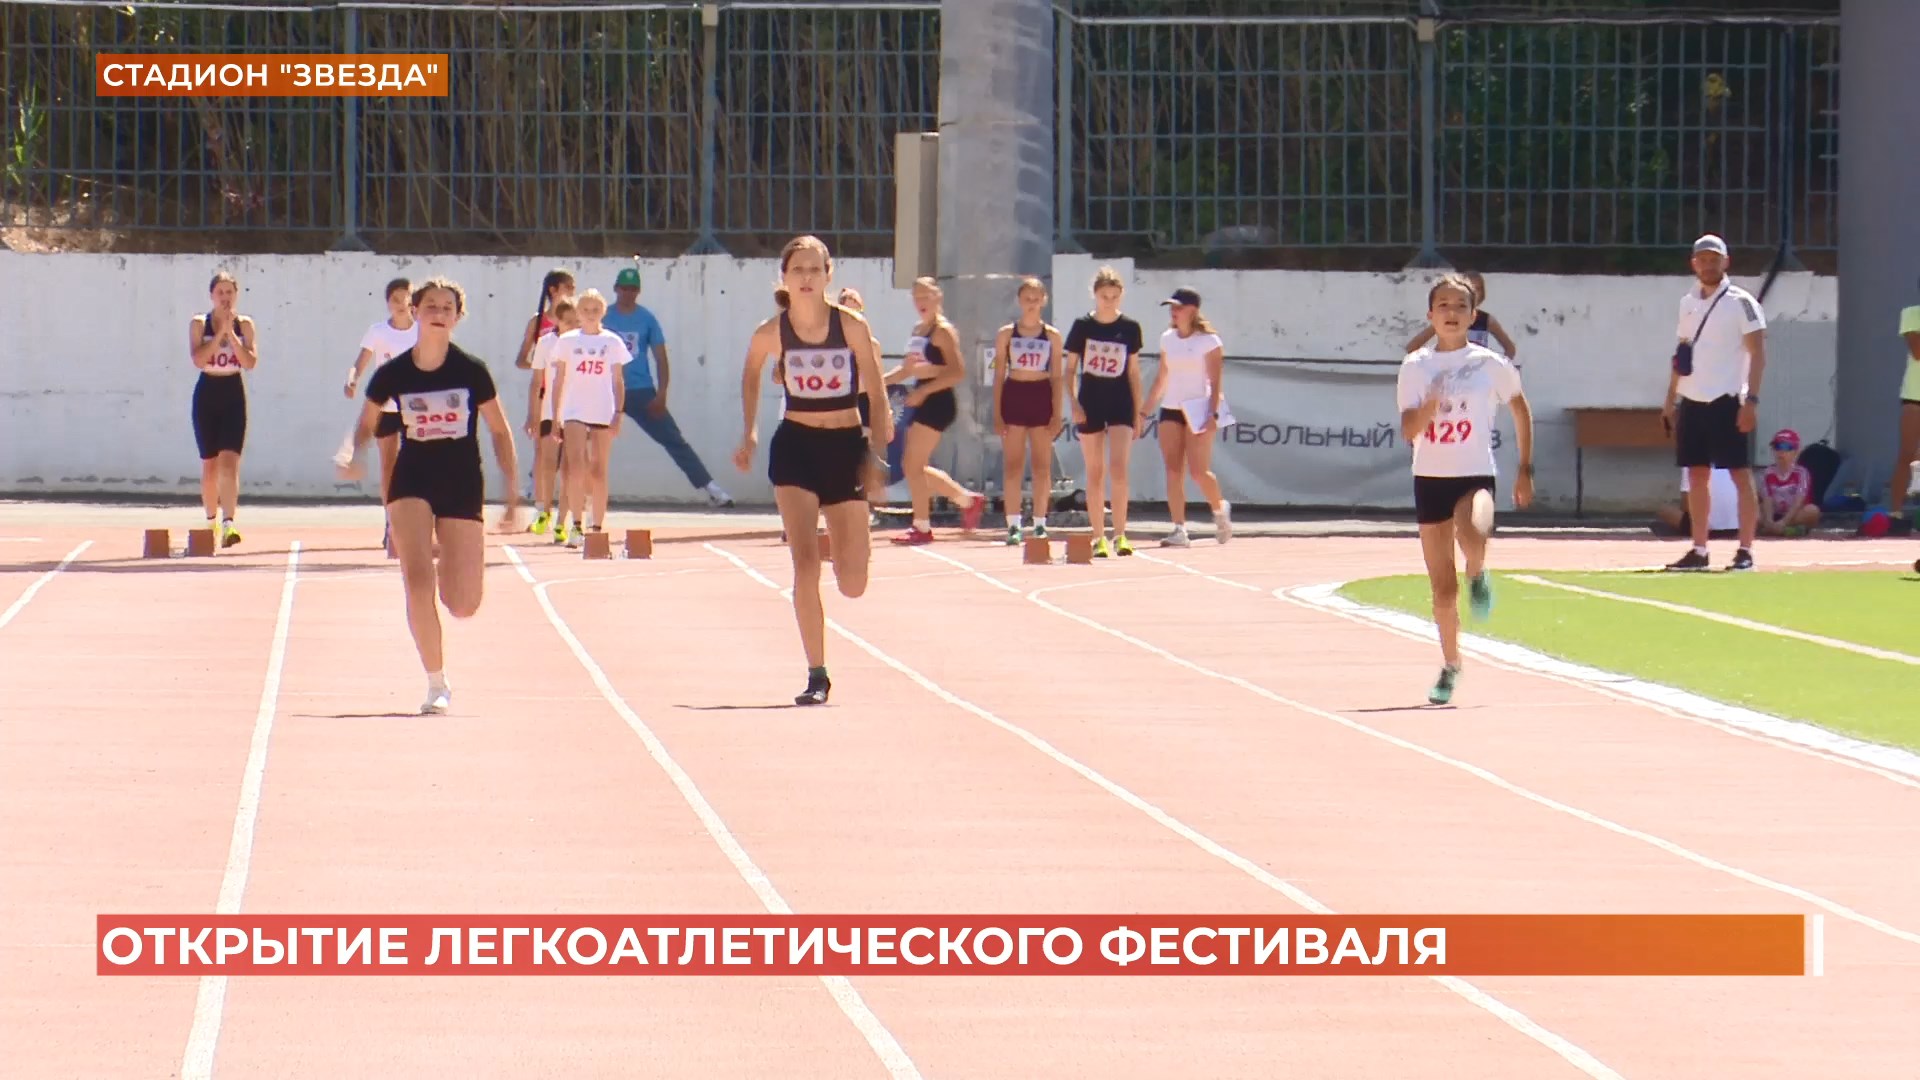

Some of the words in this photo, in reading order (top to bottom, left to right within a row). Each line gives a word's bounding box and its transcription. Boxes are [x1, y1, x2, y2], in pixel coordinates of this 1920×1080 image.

[576, 360, 604, 375] 475
[1017, 352, 1040, 367] 411
[1088, 355, 1118, 373] 412
[1222, 421, 1395, 449] ТБОЛЬНЫЙ
[1424, 420, 1472, 444] 429
